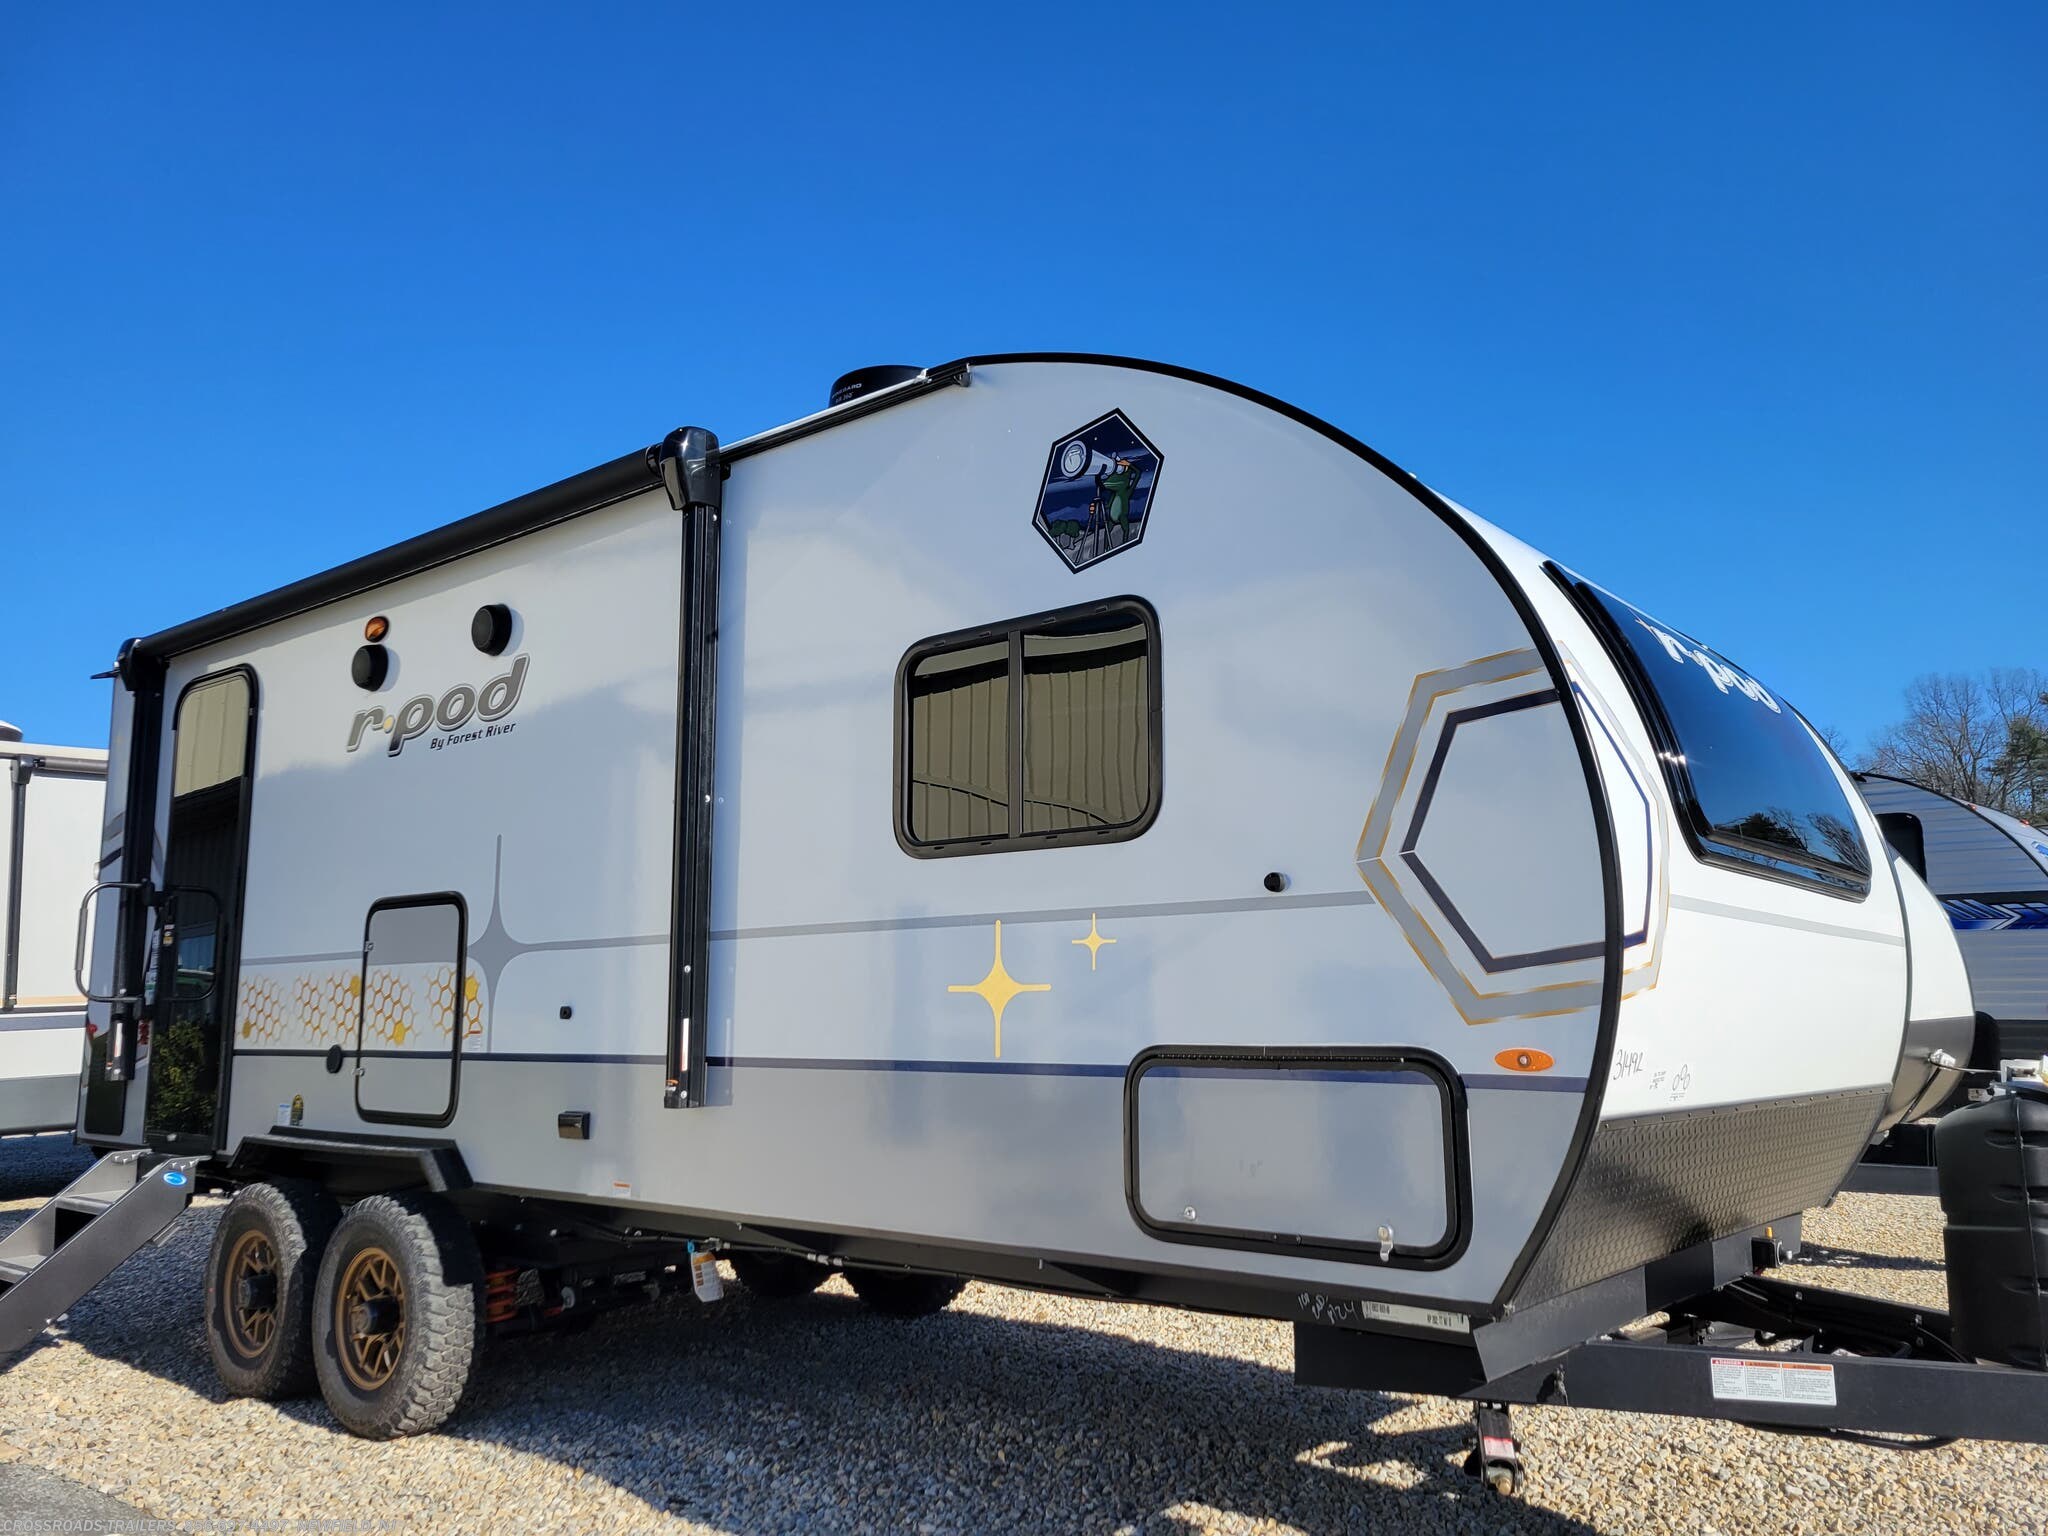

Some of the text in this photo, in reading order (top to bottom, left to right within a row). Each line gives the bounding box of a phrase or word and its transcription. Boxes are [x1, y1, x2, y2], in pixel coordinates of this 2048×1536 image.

[430, 722, 517, 750] By Forest River
